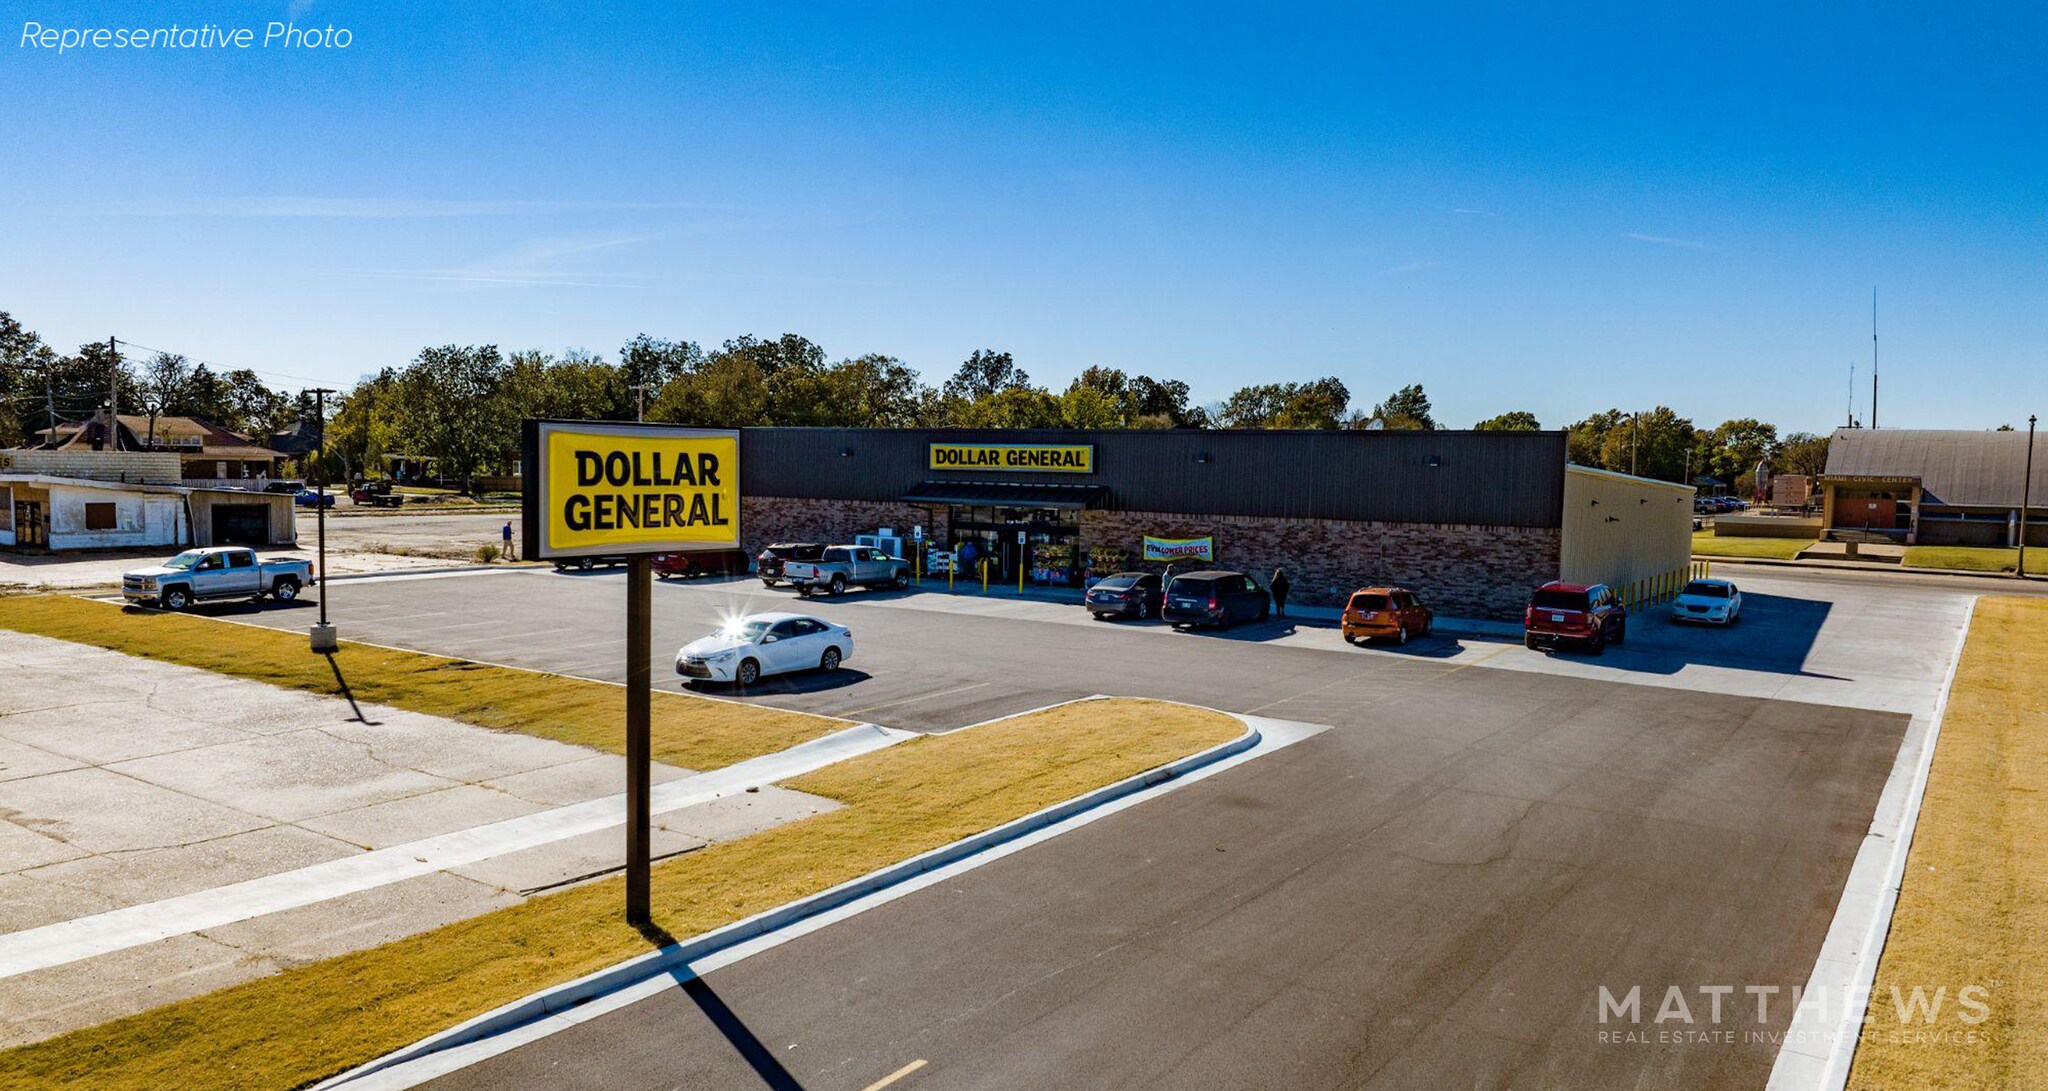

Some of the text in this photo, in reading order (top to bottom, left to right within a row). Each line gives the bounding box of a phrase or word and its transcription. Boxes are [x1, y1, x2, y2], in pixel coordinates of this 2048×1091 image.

[575, 450, 720, 487] DOLLAR
[935, 449, 1085, 466] DOLLAR GENERAL
[564, 493, 728, 531] GENERAL
[1184, 545, 1208, 555] PRICES
